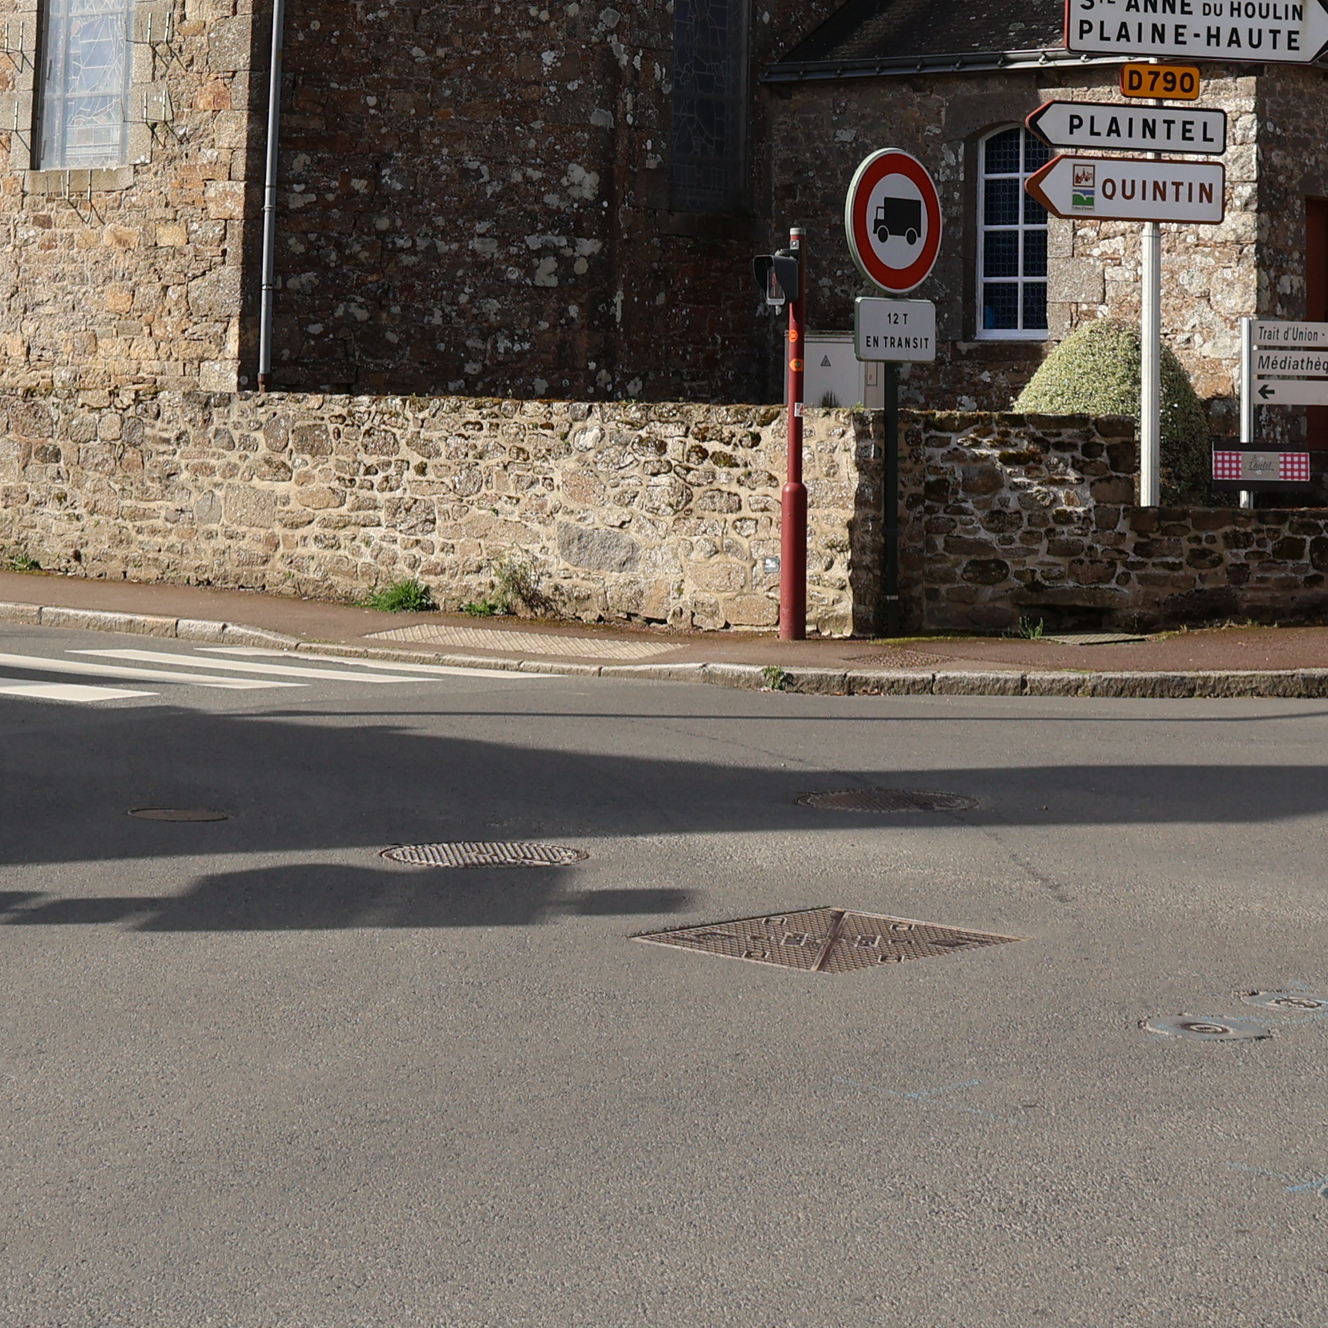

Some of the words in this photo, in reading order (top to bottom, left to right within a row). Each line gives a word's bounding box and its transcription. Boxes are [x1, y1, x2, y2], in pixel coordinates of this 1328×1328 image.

[1202, 2, 1223, 17] DU
[1230, 0, 1304, 21] HOULIN
[1078, 19, 1300, 51] PLAINE-HAUTE
[1068, 114, 1214, 142] PLAINTEL
[1101, 177, 1213, 204] QUINTIN
[887, 312, 899, 325] 12
[902, 313, 908, 325] T
[865, 335, 879, 348] EN
[883, 336, 929, 349] TRANSIT
[1258, 326, 1280, 341] Trait
[1283, 327, 1318, 342] d'Union
